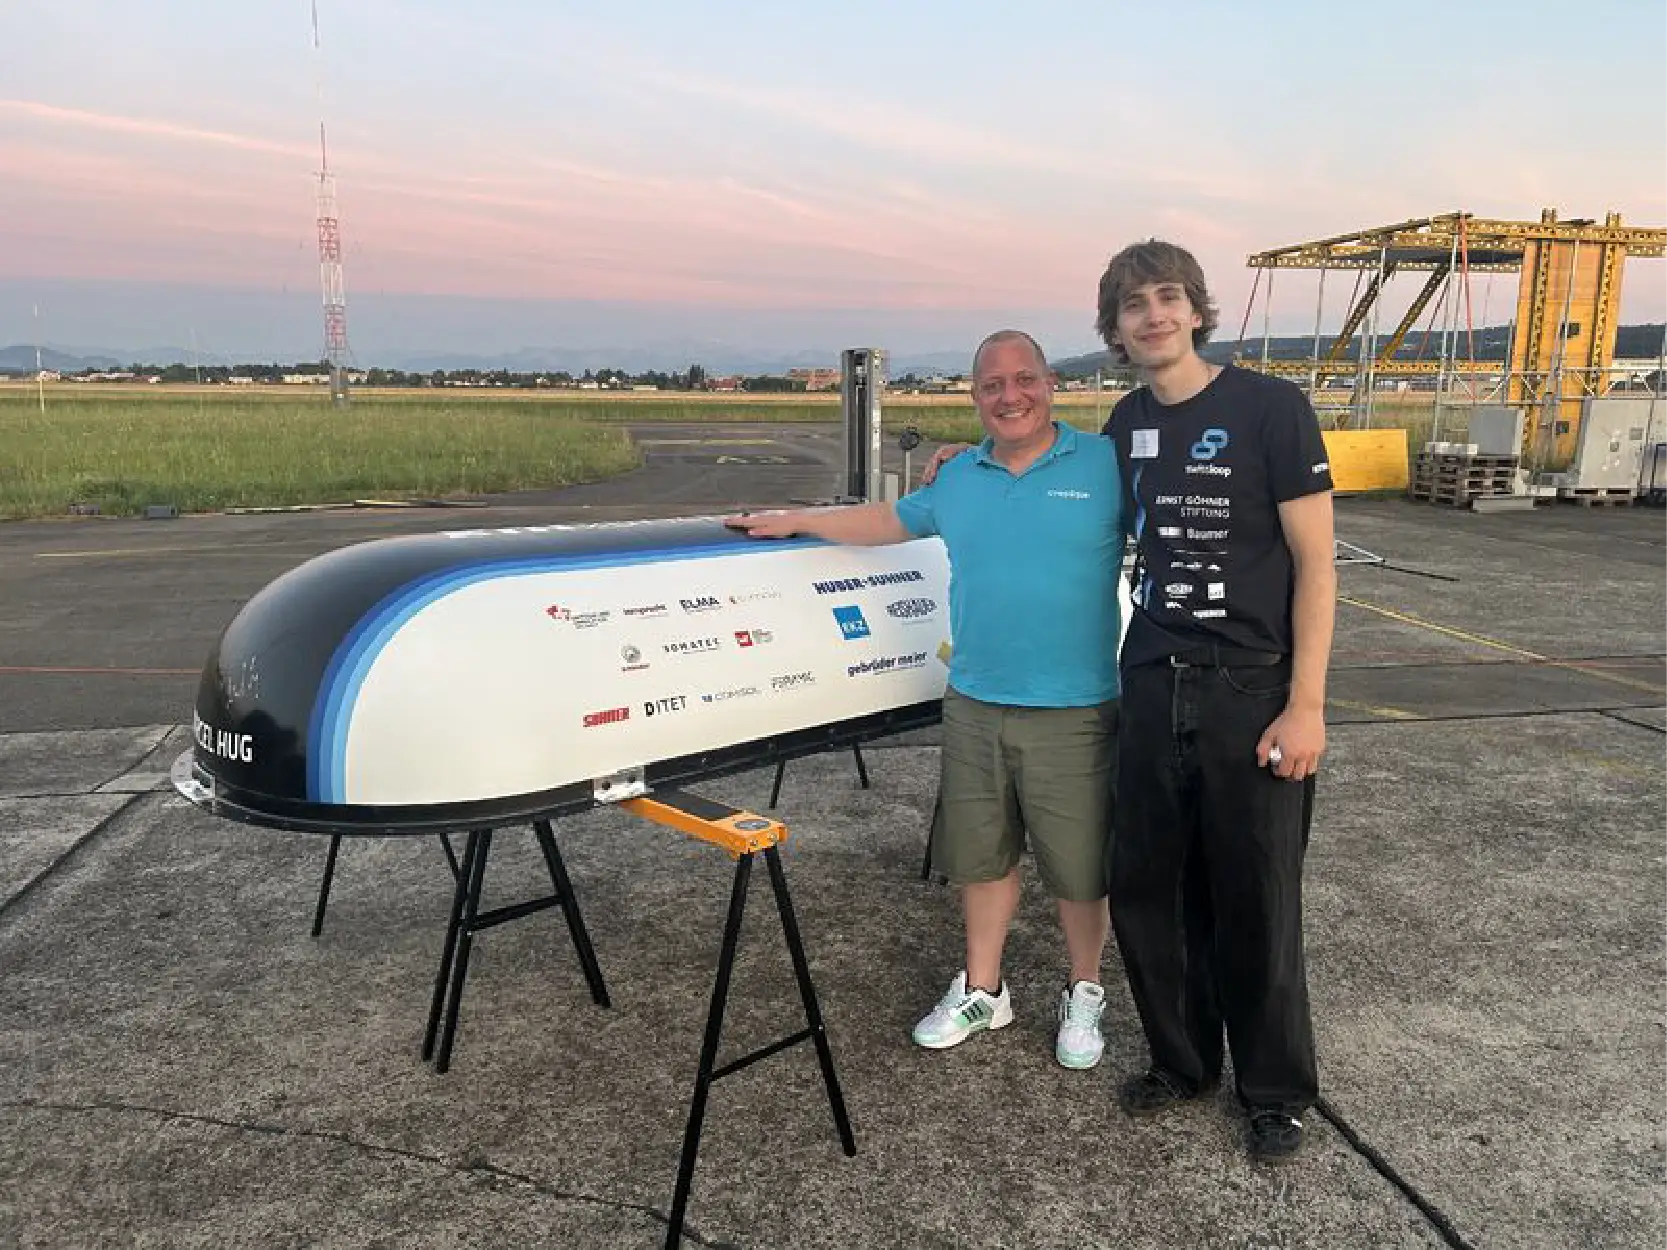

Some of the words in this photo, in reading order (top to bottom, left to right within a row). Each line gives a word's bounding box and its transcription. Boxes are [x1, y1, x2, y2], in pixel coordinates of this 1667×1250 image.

[1180, 507, 1230, 518] STIFTUNG
[643, 695, 688, 718] DITET
[216, 728, 254, 763] HUG
